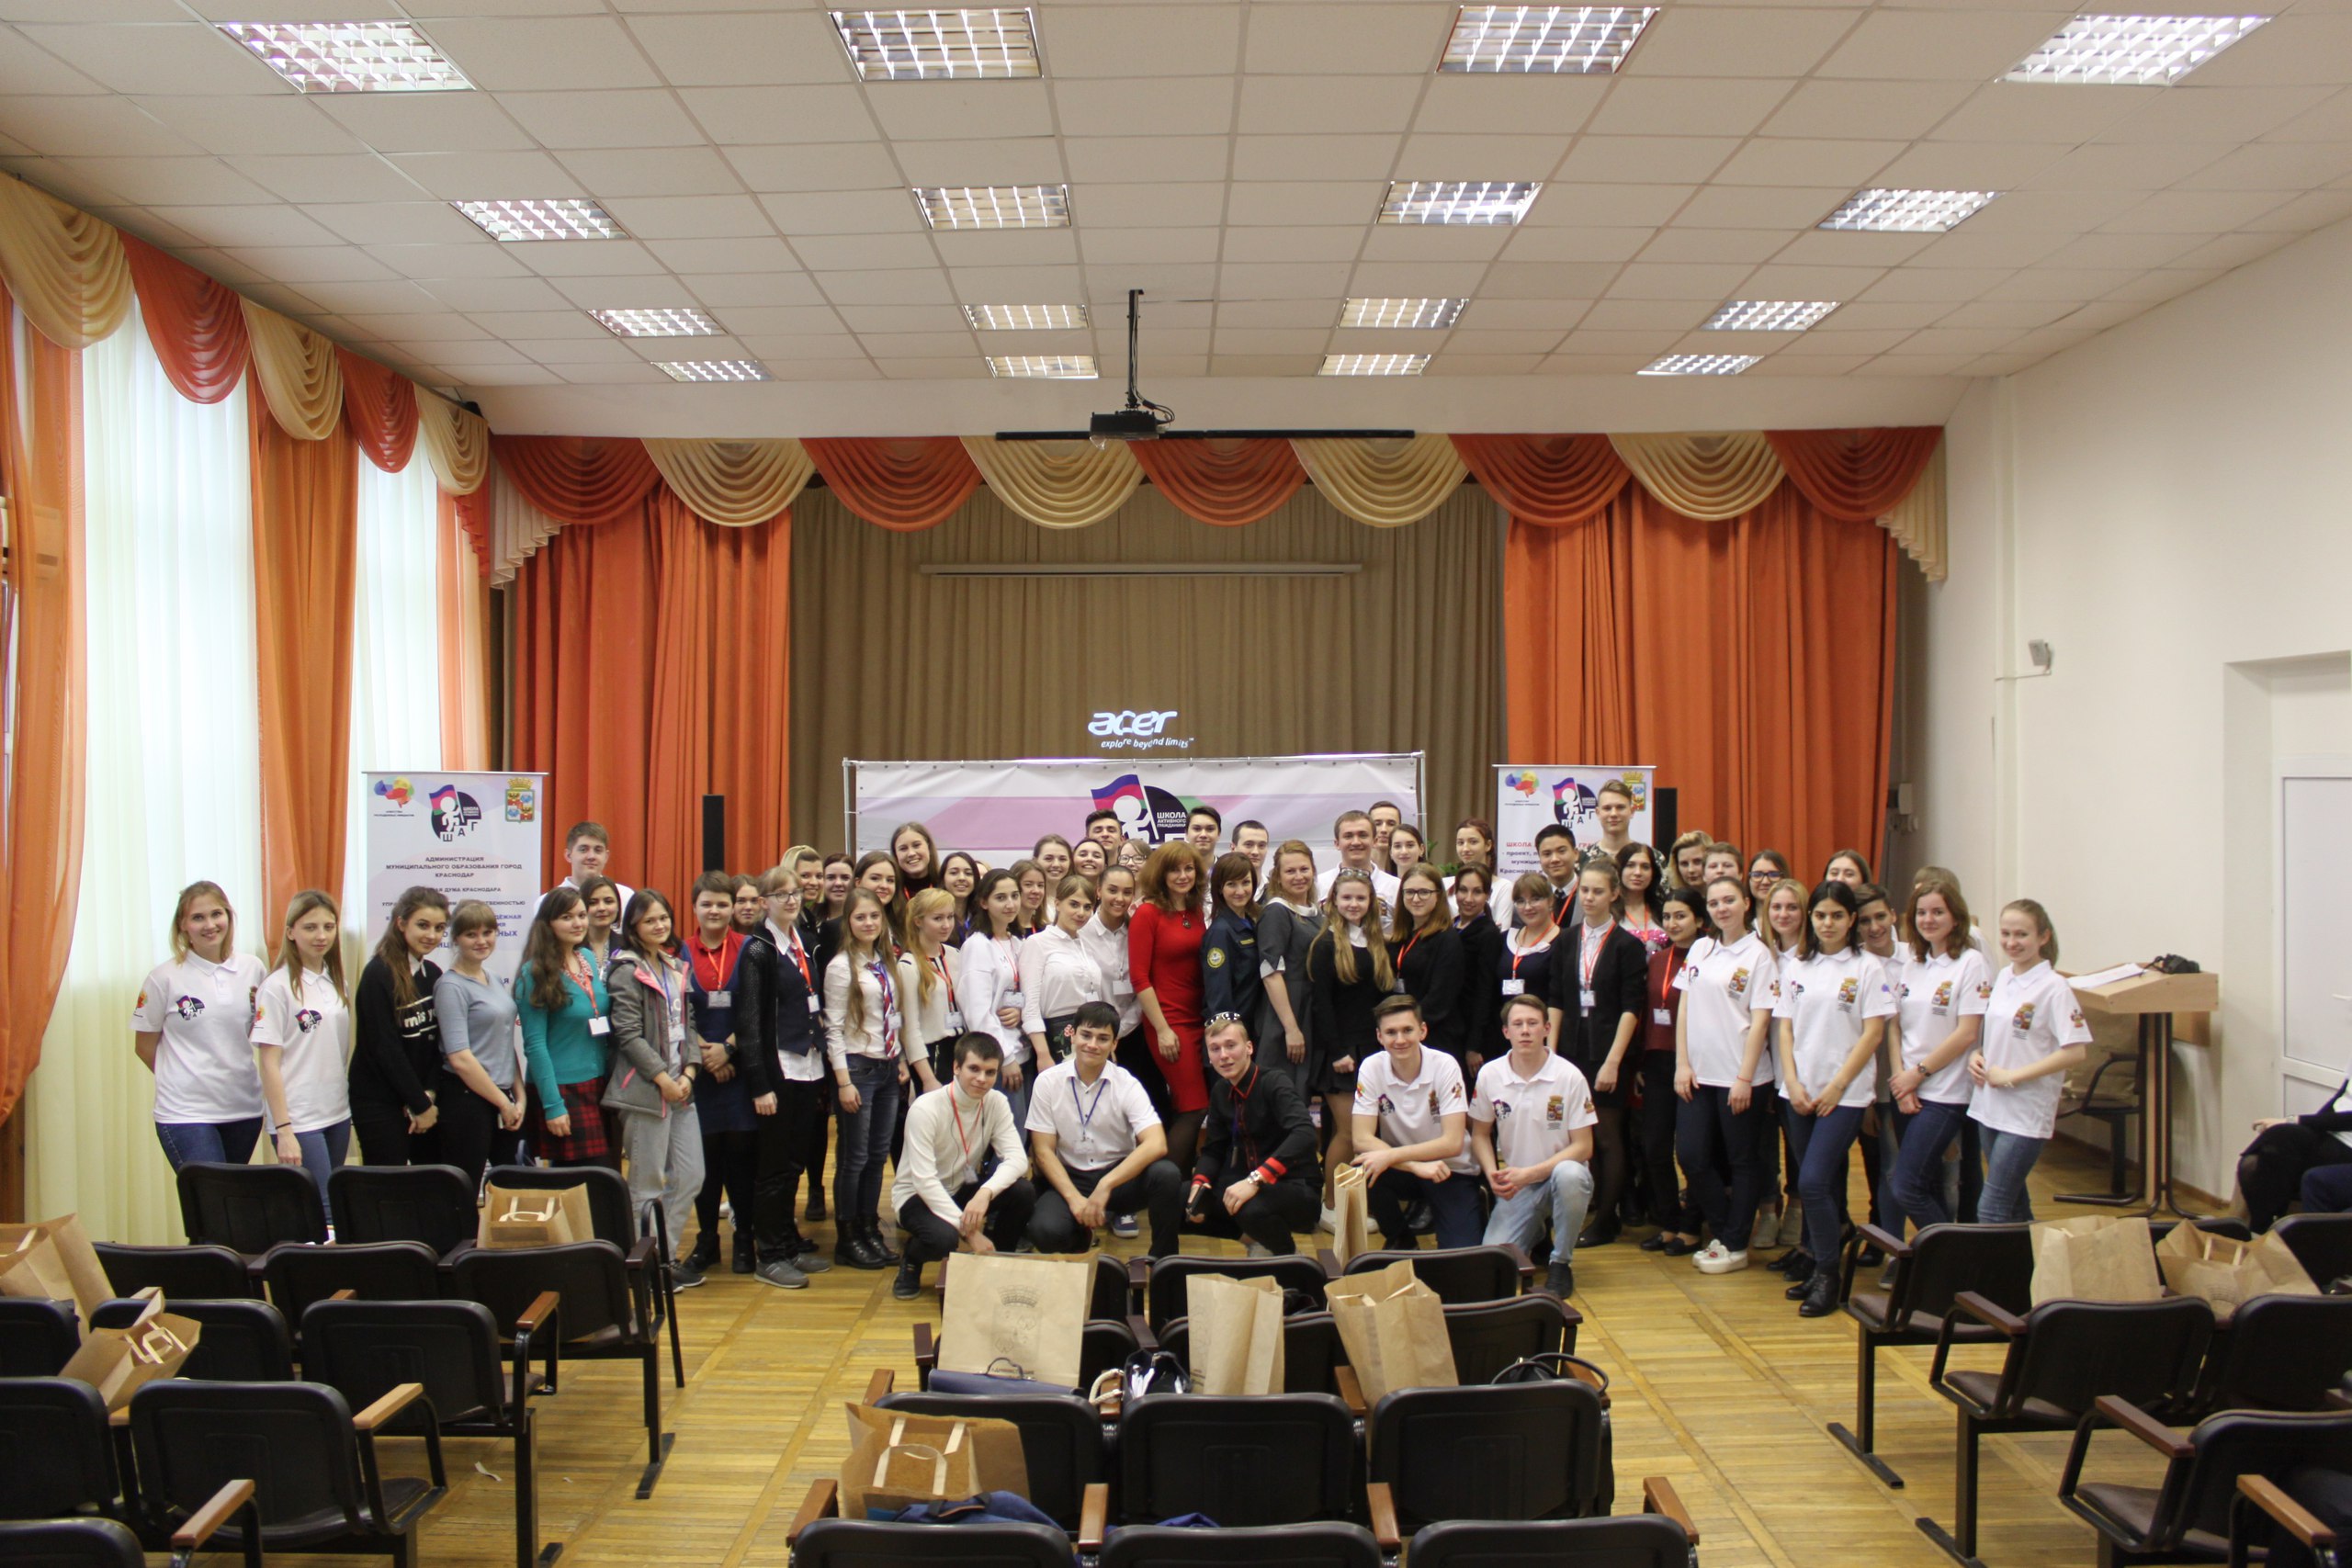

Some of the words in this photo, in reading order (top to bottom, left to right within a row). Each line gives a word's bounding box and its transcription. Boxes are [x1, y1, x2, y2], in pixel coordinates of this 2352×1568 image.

[1088, 710, 1178, 736] acer
[1101, 739, 1132, 749] explore
[1133, 738, 1164, 750] beyond
